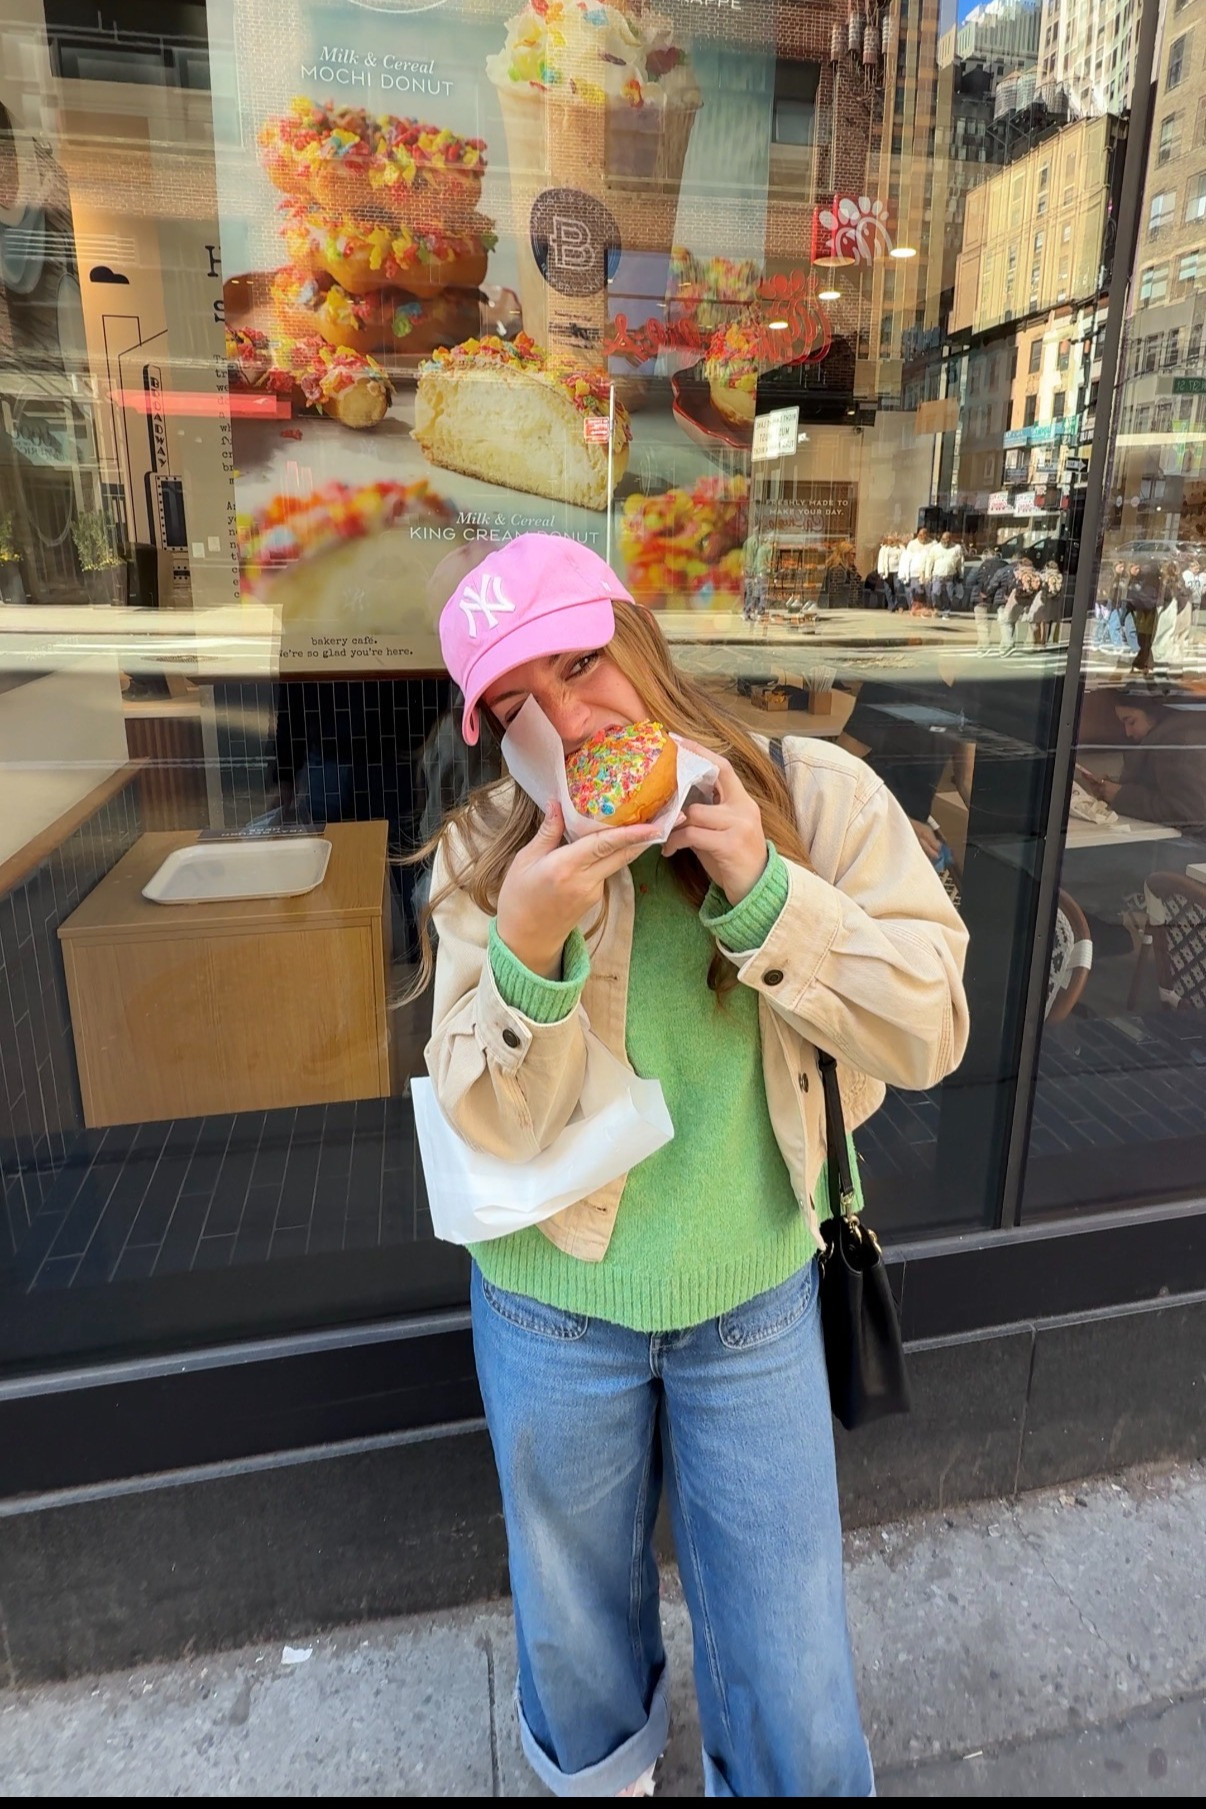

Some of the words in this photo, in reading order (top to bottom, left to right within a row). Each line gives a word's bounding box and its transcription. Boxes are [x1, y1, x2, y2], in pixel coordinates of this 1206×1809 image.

[320, 46, 360, 65] Milk
[364, 51, 377, 67] &
[382, 54, 435, 74] Cereal
[301, 65, 371, 87] MOCHI
[381, 73, 454, 96] DONUT
[456, 511, 491, 526] Milk
[494, 513, 506, 526] &
[510, 513, 556, 528] Cereal
[410, 526, 456, 541] KING
[459, 573, 517, 640] NY
[311, 636, 348, 646] bakery
[352, 635, 378, 645] café.
[307, 650, 319, 658] so
[323, 648, 347, 659] glad
[350, 648, 383, 658] you're
[386, 647, 414, 656] here.
